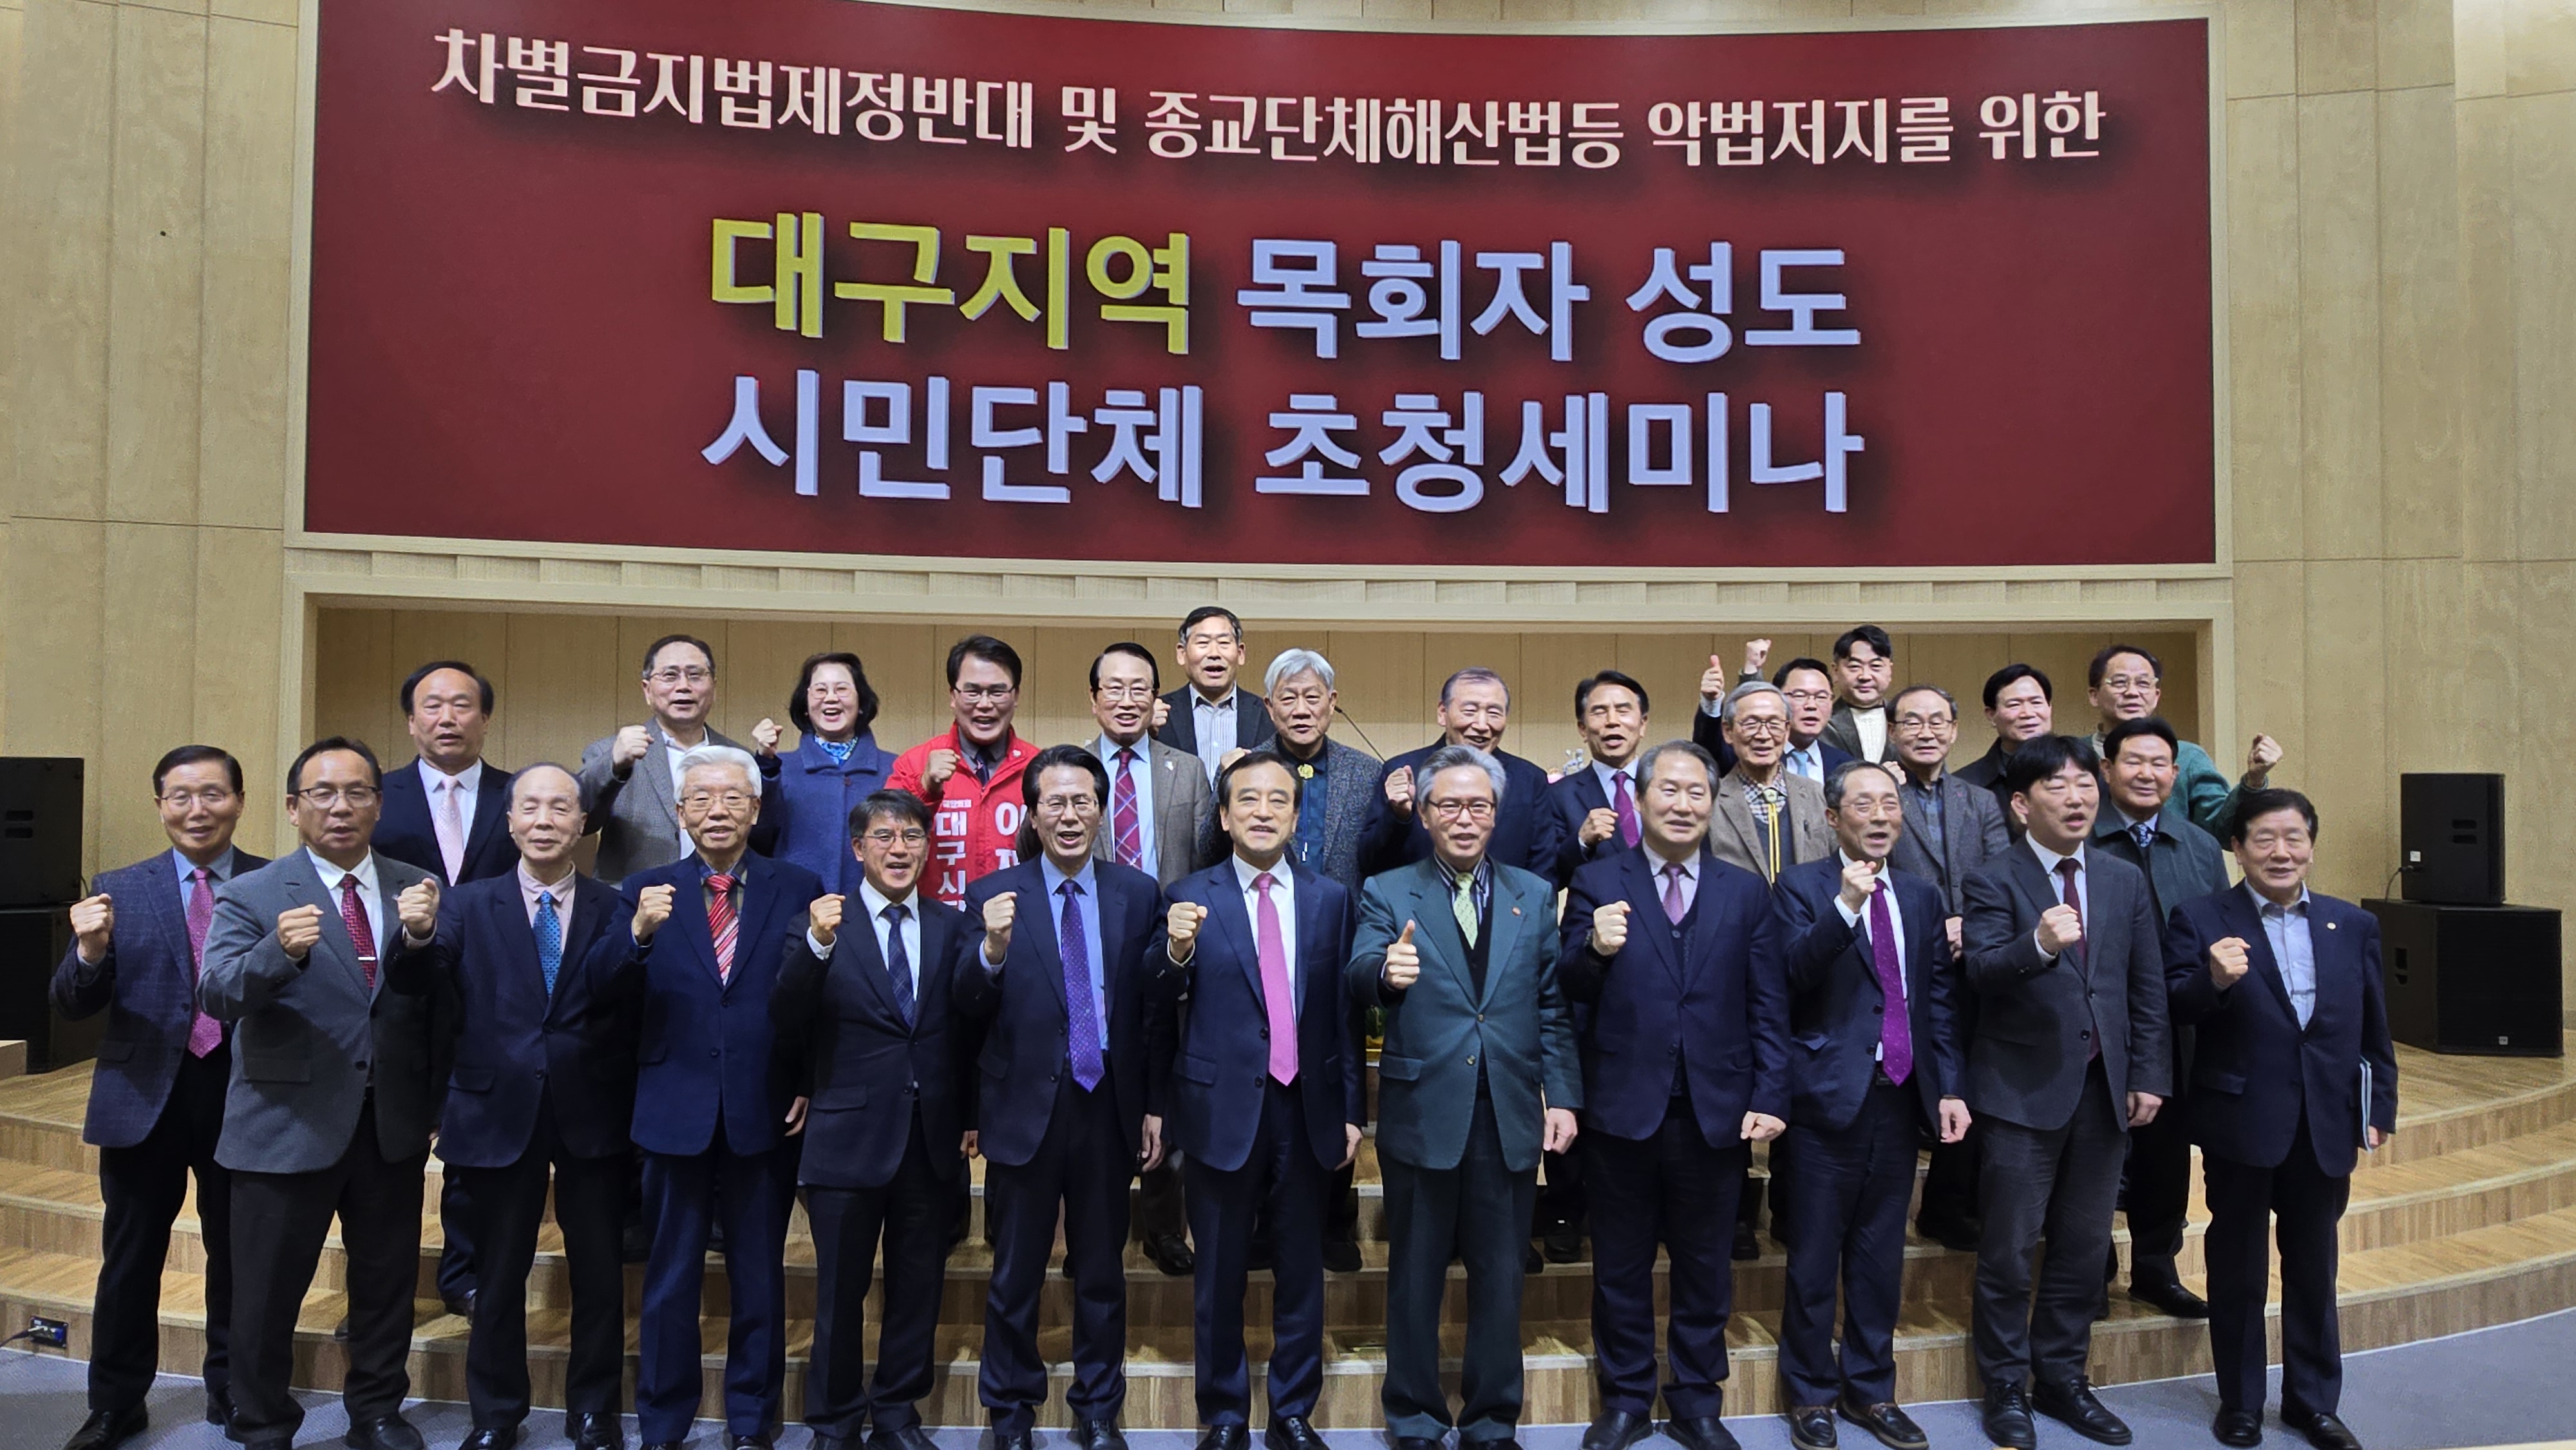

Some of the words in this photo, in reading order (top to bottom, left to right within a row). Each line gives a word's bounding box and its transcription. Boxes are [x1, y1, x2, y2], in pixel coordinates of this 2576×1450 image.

[431, 28, 1033, 149] 차별금지법제정반대
[1061, 86, 1117, 154] 및
[1144, 91, 1624, 169] 종교단체해산법등
[1647, 97, 1954, 166] 악법저지를
[1978, 90, 2107, 160] 위한
[711, 211, 1189, 355] 대구지역
[1237, 239, 1590, 361] 목회자
[1625, 241, 1861, 363] 성도
[701, 369, 1203, 508] 시민단체
[1255, 391, 1864, 513] 초청세미나
